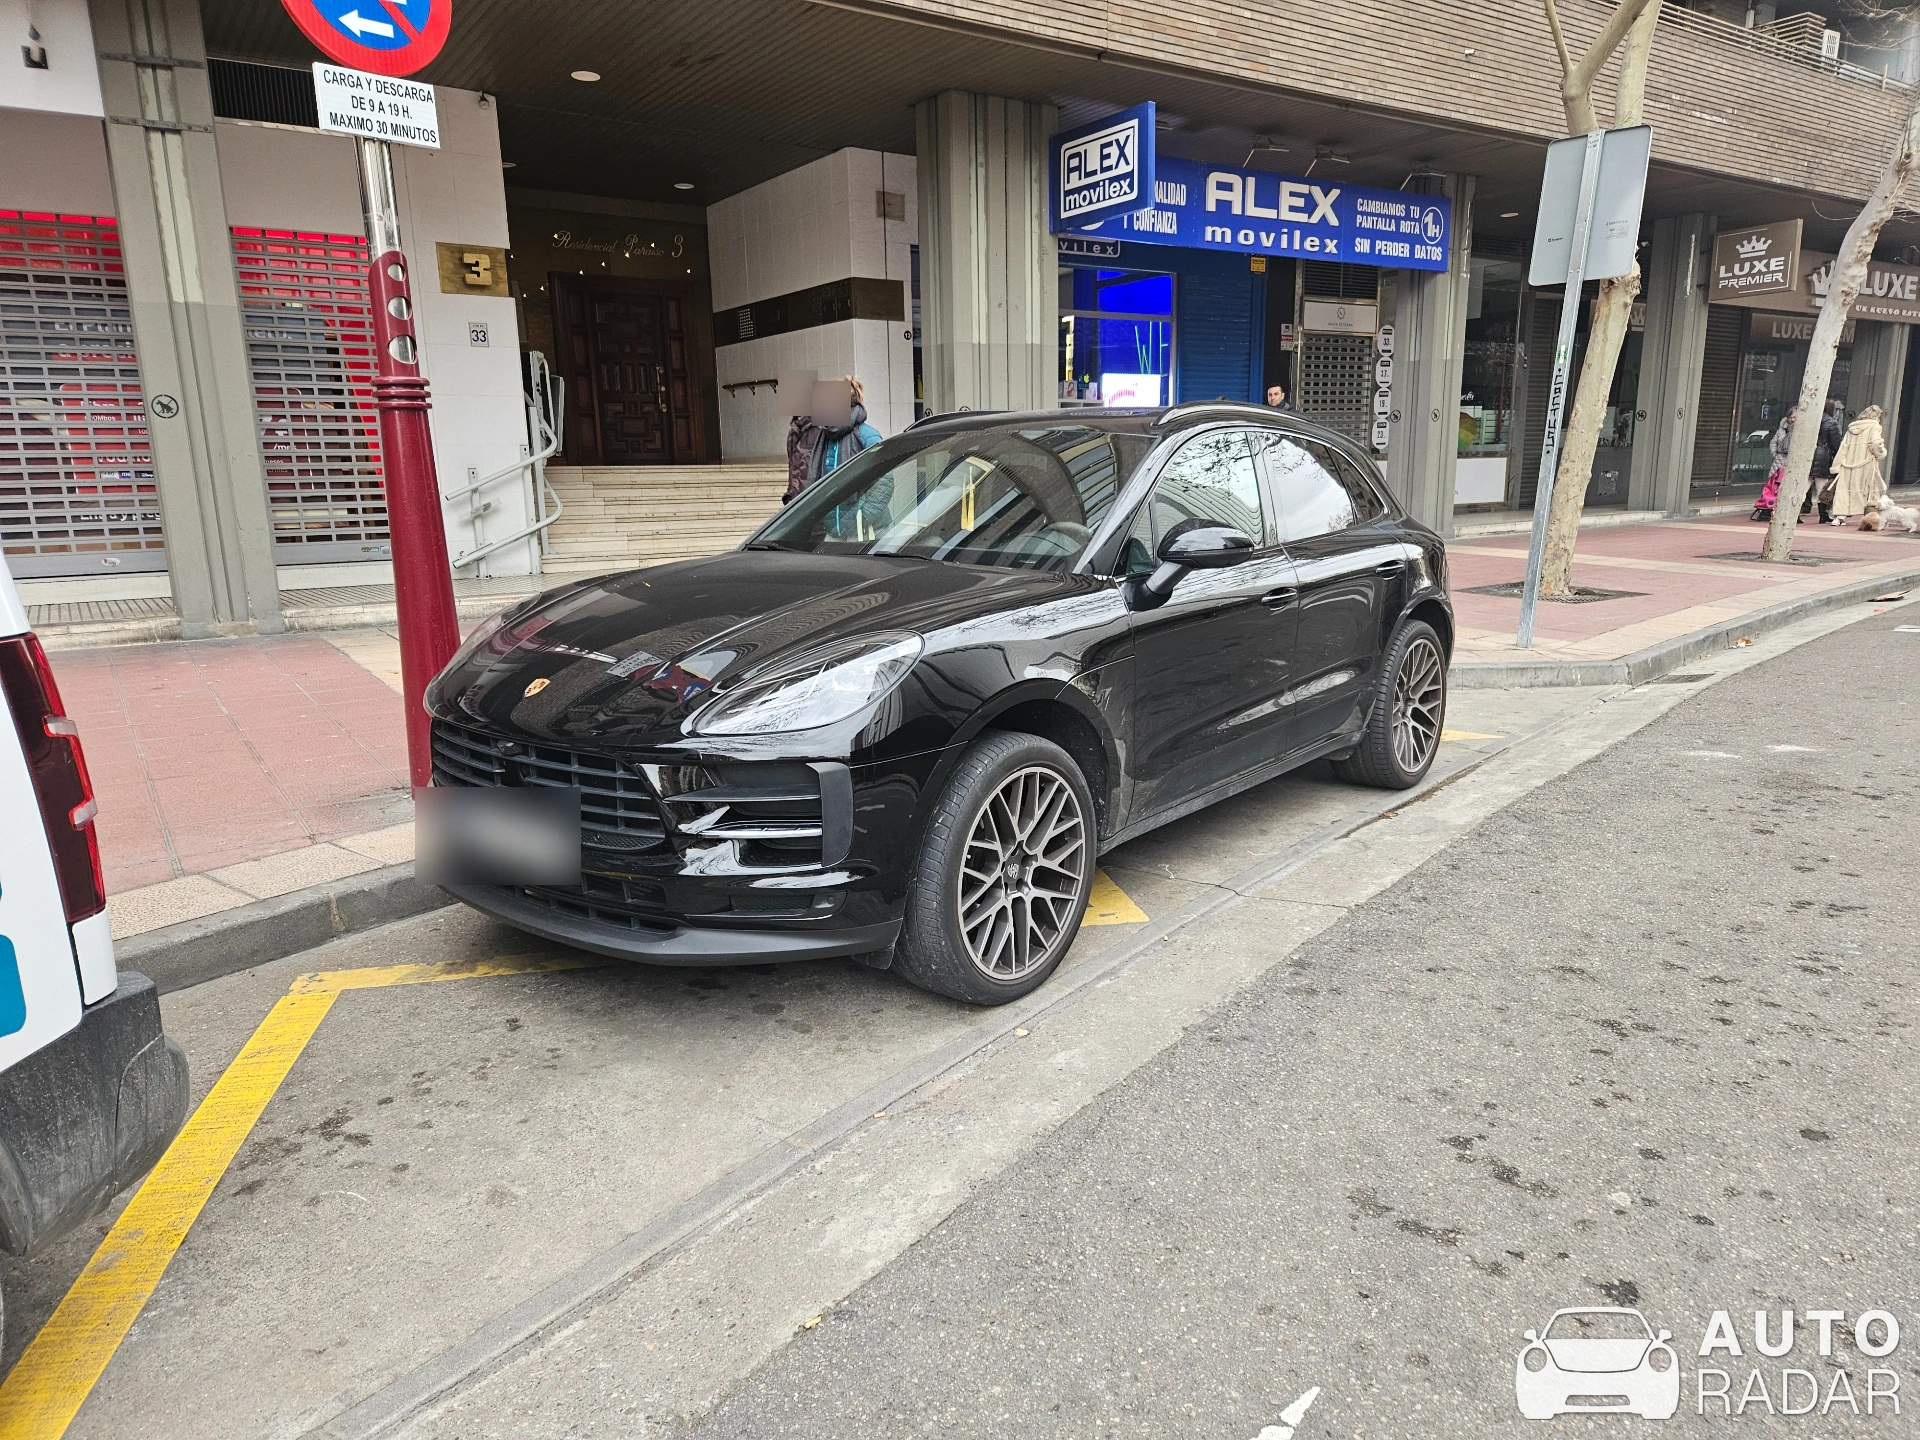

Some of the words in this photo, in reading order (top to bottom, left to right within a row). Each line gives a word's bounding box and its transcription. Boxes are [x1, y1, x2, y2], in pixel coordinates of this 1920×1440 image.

[323, 69, 364, 91] CARGA
[365, 77, 372, 92] Y
[375, 79, 434, 104] DESCARGA
[351, 95, 367, 111] DE
[369, 98, 375, 112] 9
[378, 100, 386, 115] A
[388, 102, 400, 117] 19
[402, 104, 413, 120] H.
[329, 111, 374, 132] MAXIMO
[376, 120, 388, 135] 30
[390, 122, 437, 143] MINUTOS
[1067, 134, 1131, 184] ALEX
[1065, 177, 1131, 211] movilex
[1206, 171, 1341, 227] ALEX
[1133, 209, 1178, 235] CONFIANZA
[1357, 198, 1406, 214] CAMBIAMOS
[1409, 205, 1420, 219] TU
[1356, 214, 1396, 232] PANTALLA
[1400, 220, 1420, 235] ROTA
[552, 230, 617, 253] Residencial
[671, 234, 684, 258] 3
[1205, 225, 1338, 254] movilex
[1355, 237, 1371, 254] SIN
[1375, 240, 1410, 258] PERDER
[1414, 245, 1443, 261] DATOS
[463, 253, 492, 286] 3
[1718, 272, 1784, 289] PREMIER
[1719, 257, 1785, 278] LUXE
[1859, 270, 1918, 300] LUXE
[471, 329, 487, 343] 33
[1771, 321, 1812, 341] LUXE
